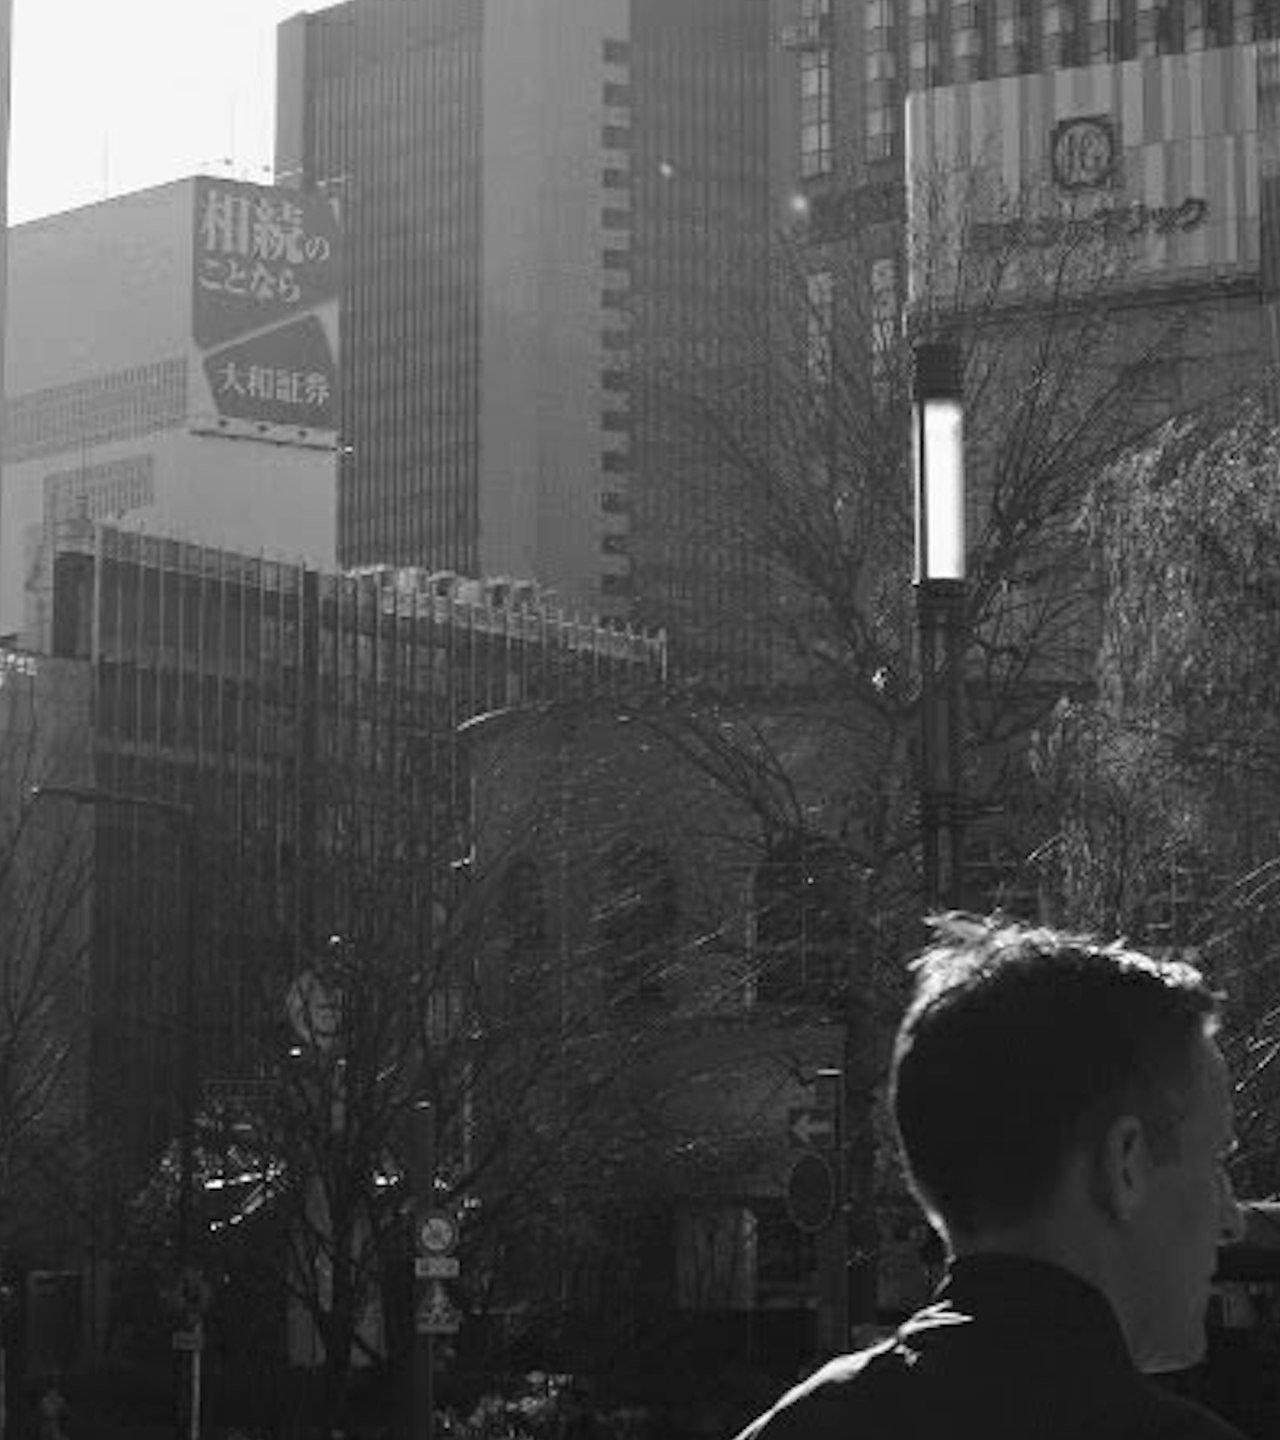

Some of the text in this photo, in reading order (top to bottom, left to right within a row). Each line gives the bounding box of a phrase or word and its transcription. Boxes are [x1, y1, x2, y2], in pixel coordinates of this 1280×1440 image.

[200, 188, 330, 264] 相続の
[198, 258, 301, 303] ことなら
[218, 361, 330, 406] 大和証券
